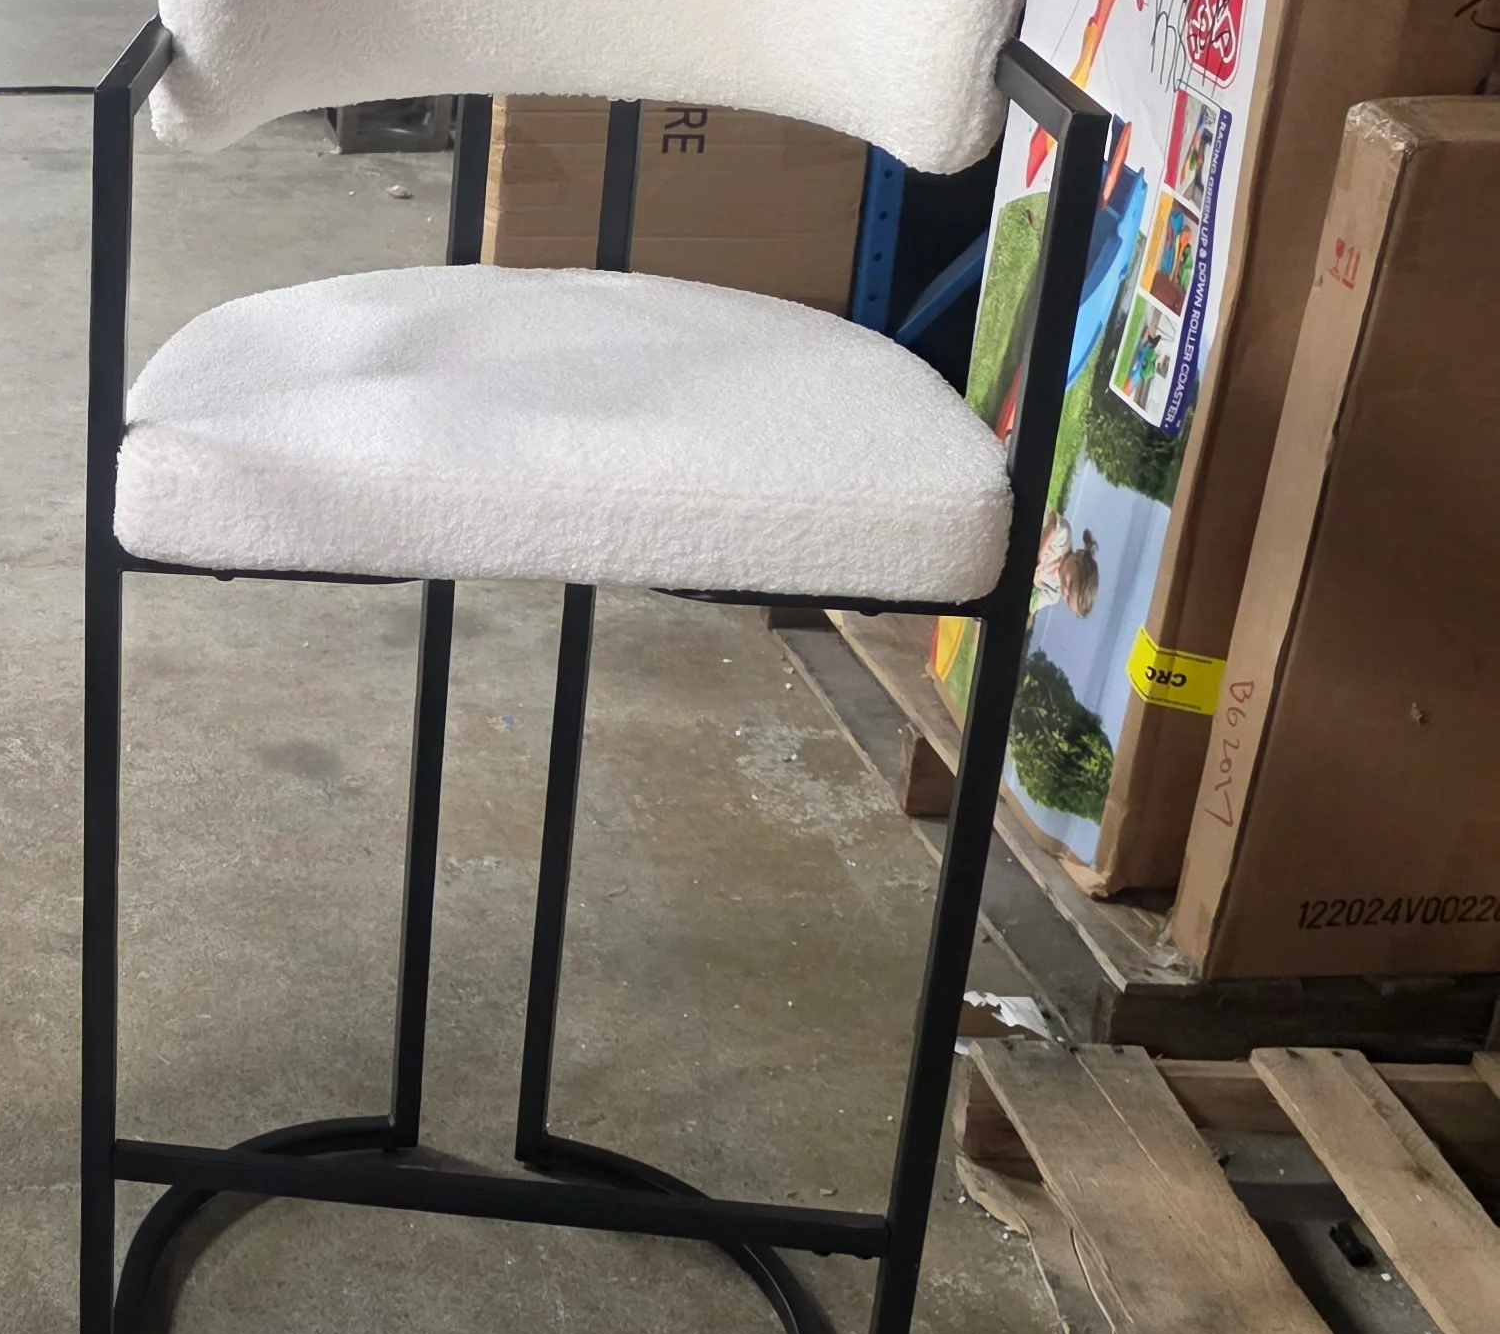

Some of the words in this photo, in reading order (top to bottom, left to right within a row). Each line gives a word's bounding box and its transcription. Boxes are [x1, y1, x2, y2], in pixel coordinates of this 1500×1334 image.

[1210, 120, 1227, 175] RACING
[1203, 177, 1217, 223] GREEN
[1199, 225, 1209, 246] UP
[1194, 262, 1207, 308] DOWN
[1183, 310, 1201, 362] ROLLER
[1165, 364, 1191, 423] COASTER
[1144, 665, 1188, 688] CRC
